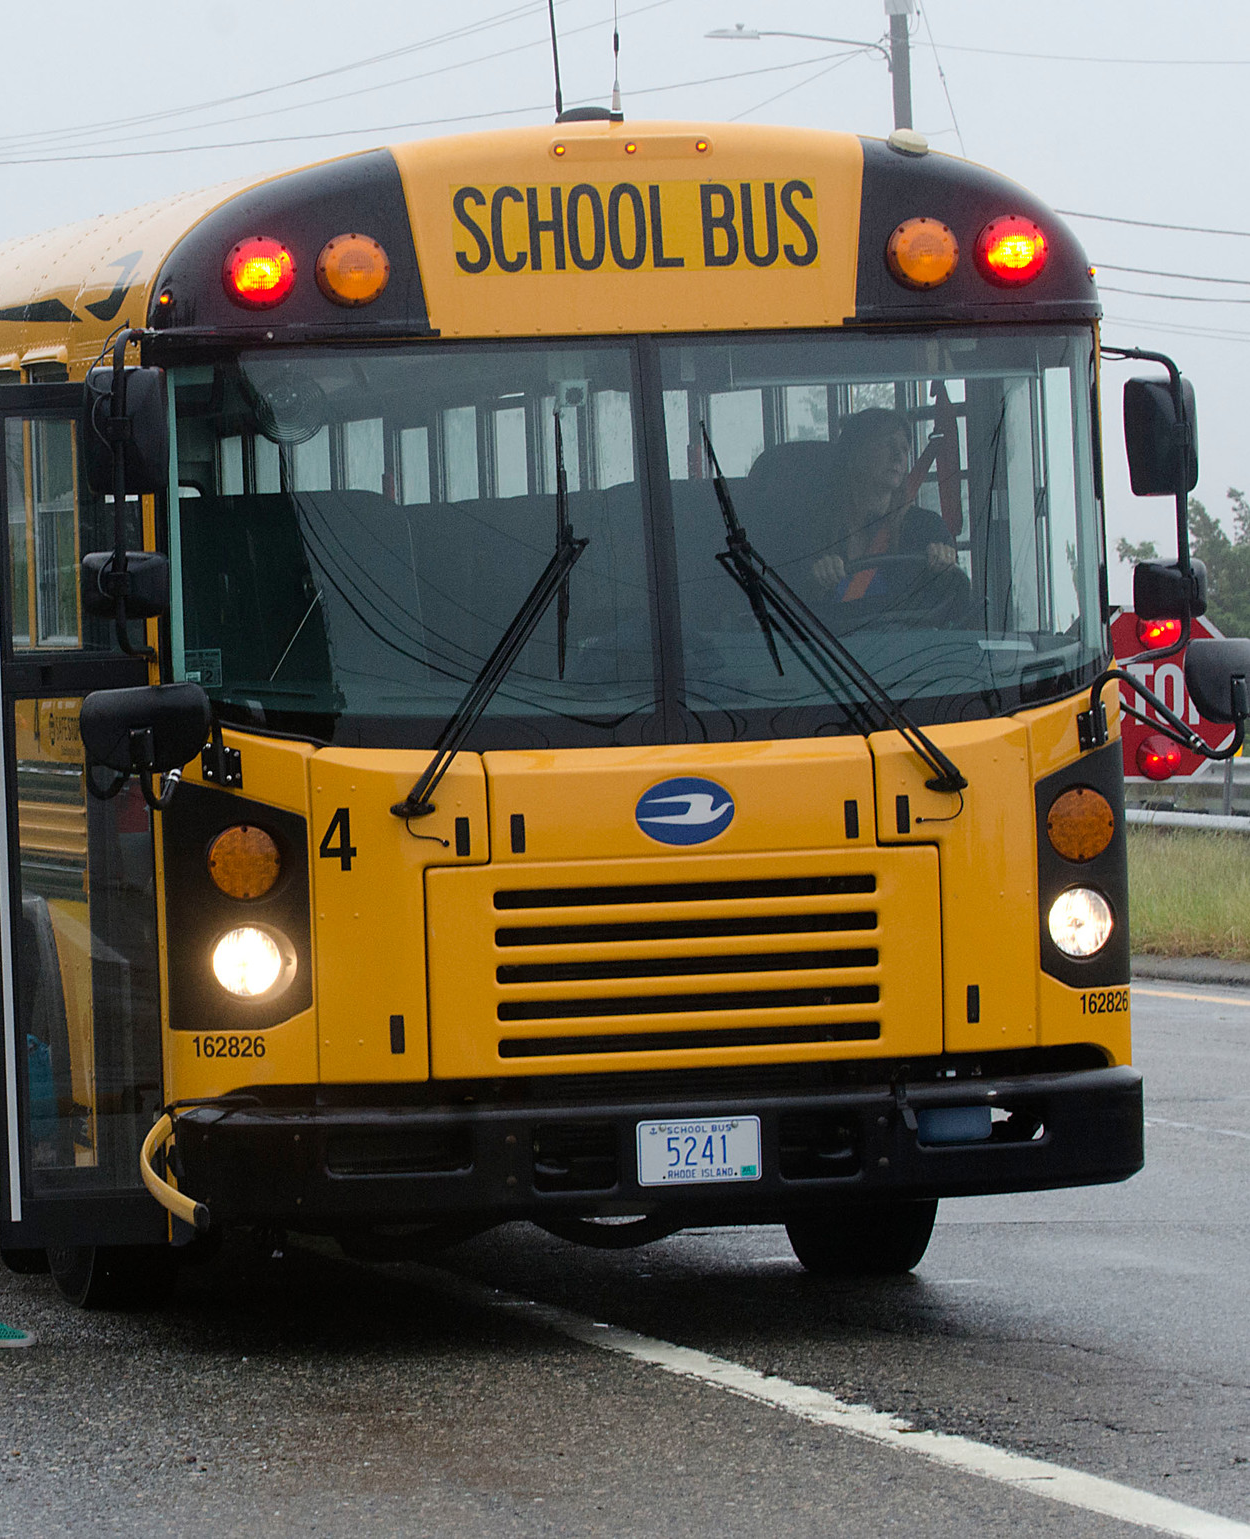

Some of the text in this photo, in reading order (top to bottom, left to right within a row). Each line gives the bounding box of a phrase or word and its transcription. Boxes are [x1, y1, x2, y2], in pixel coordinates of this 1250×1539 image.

[453, 180, 819, 274] SCHOOL BUS
[1118, 663, 1200, 725] TO
[319, 807, 357, 871] 4
[1080, 990, 1129, 1014] 162826
[192, 1036, 266, 1058] 162826
[666, 1123, 732, 1135] SCHOOL BUS
[667, 1134, 727, 1167] 5241
[667, 1168, 696, 1179] RHODE
[701, 1166, 734, 1177] ISLAND
